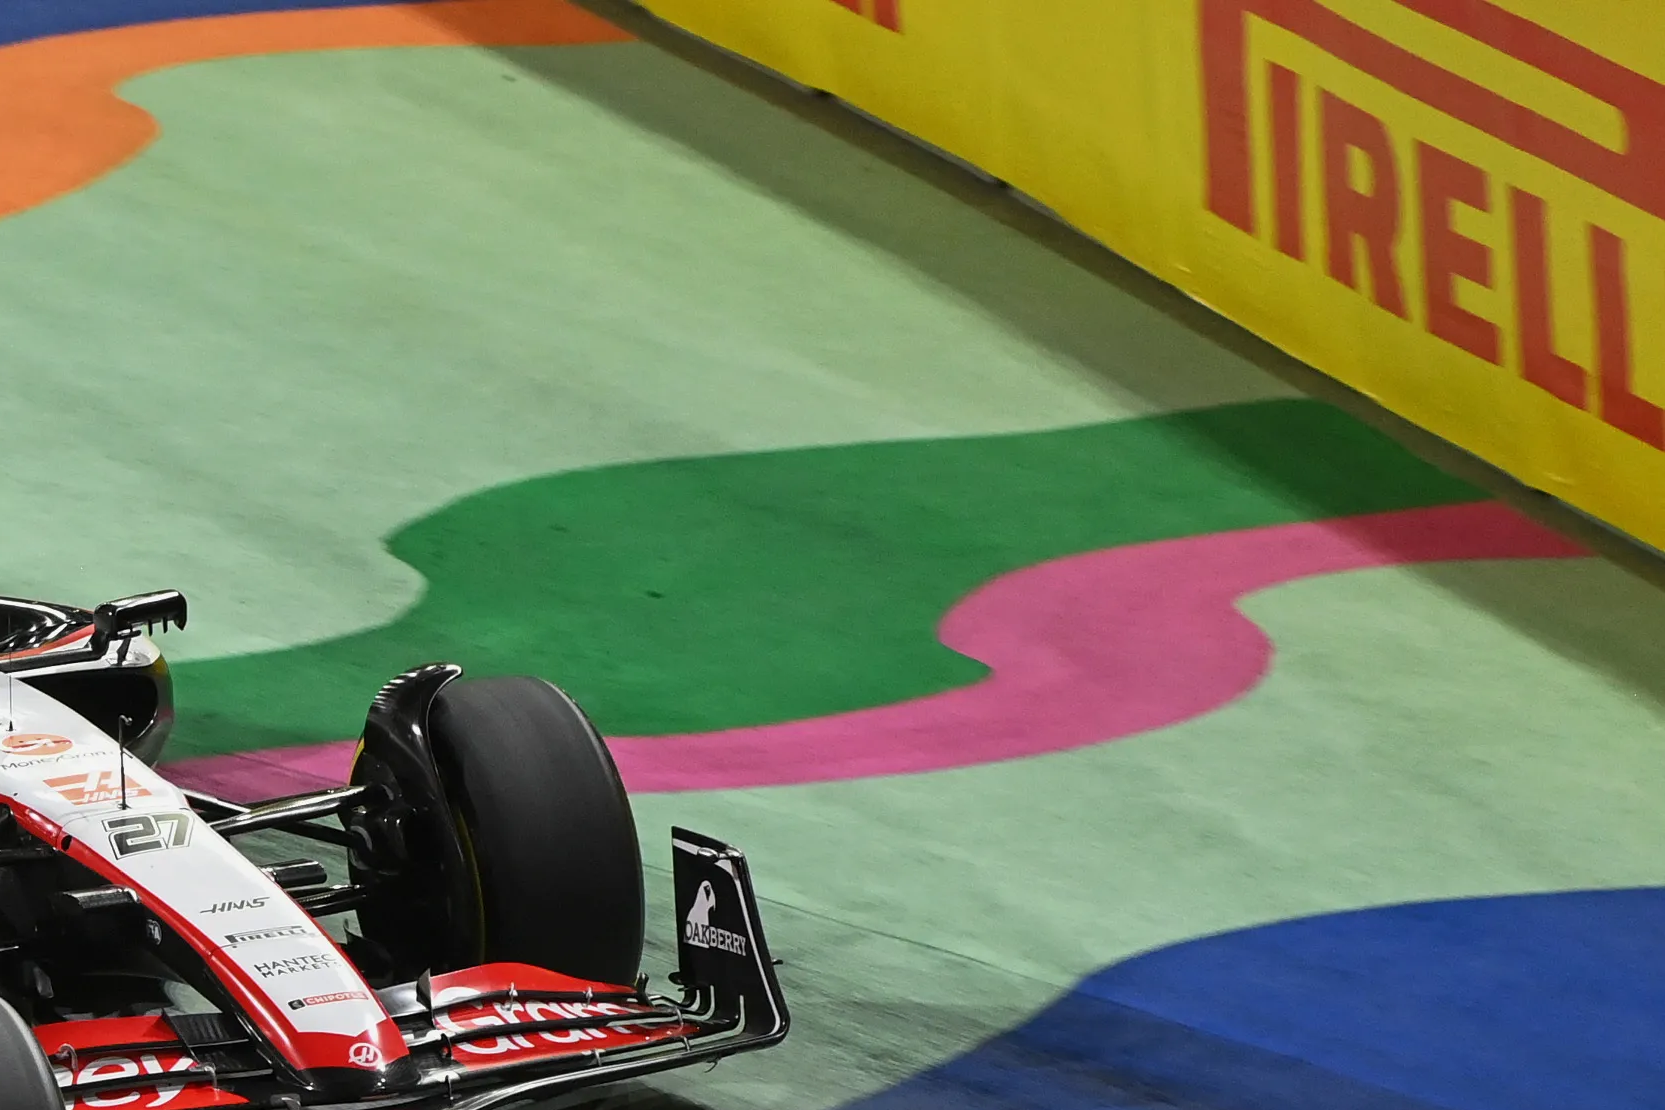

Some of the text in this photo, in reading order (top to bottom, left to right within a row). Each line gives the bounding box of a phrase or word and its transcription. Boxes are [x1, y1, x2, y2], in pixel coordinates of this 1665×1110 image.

[101, 812, 194, 860] 27
[200, 897, 270, 914] HAAS
[224, 925, 308, 944] PIRELLI
[684, 920, 746, 957] OAKBERRY
[254, 953, 337, 973] HANTEC
